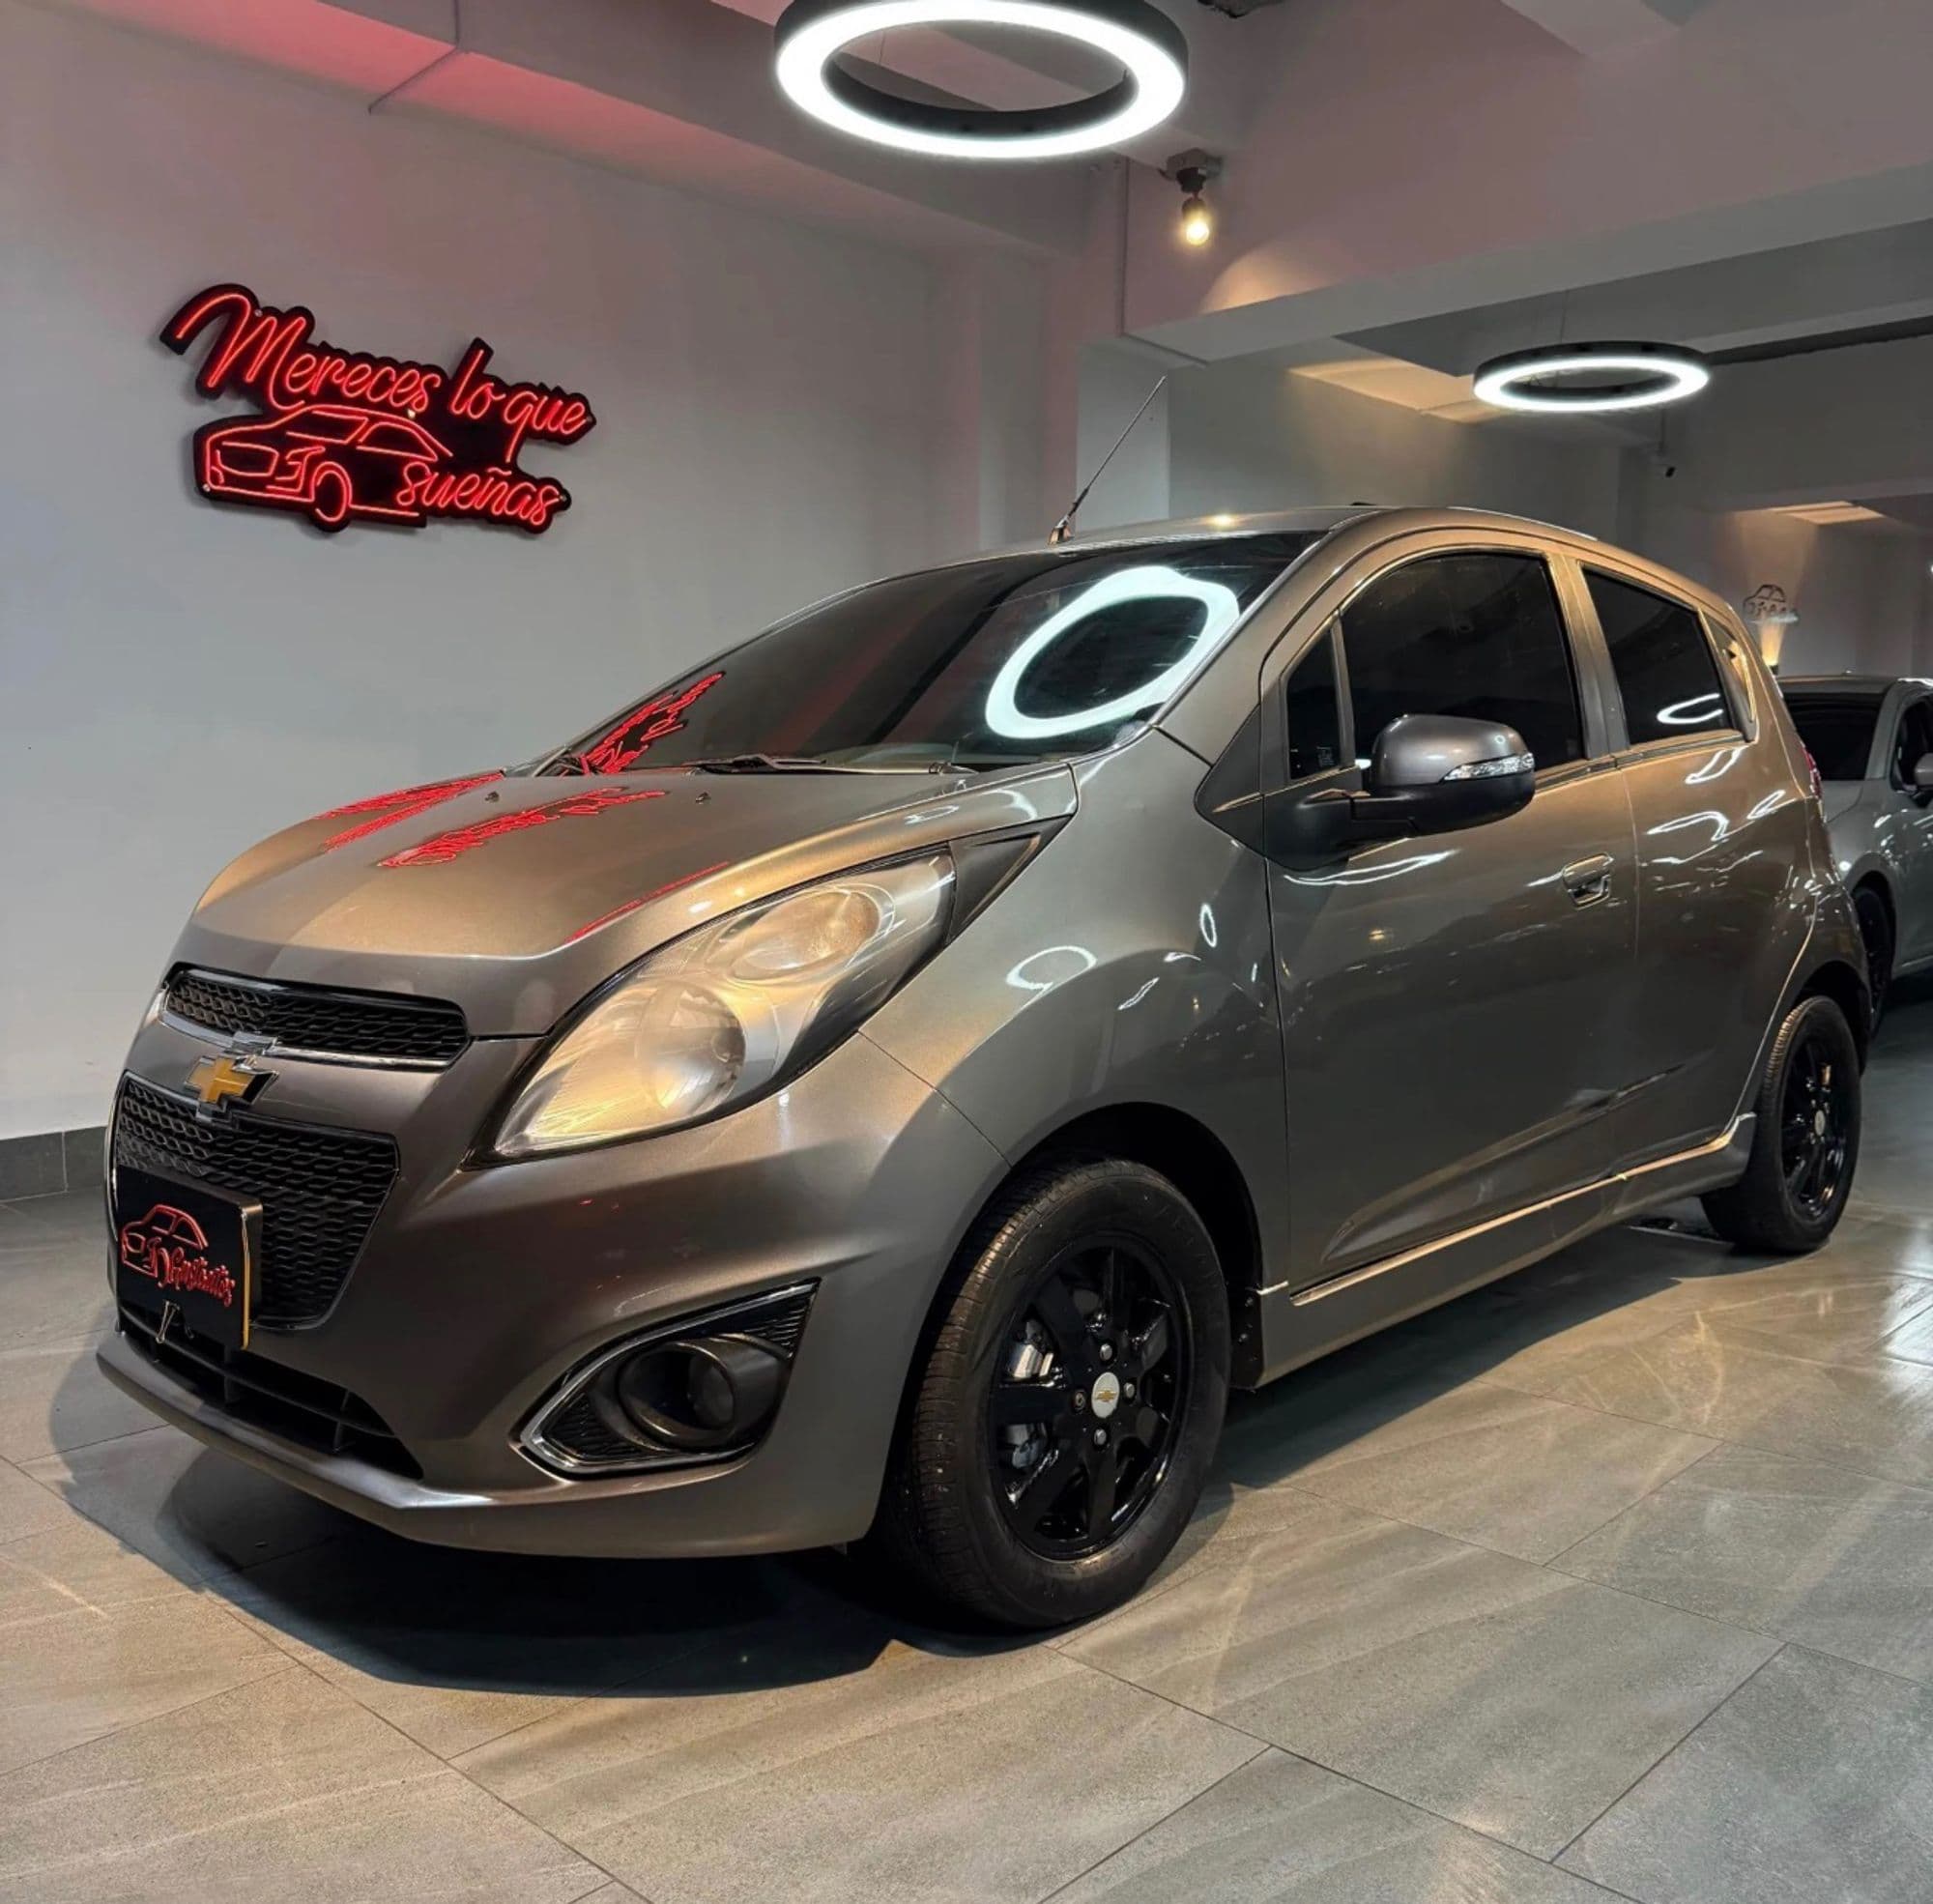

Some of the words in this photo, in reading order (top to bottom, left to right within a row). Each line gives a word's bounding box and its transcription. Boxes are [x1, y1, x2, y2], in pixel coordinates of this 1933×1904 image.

[175, 292, 441, 411] Mereces
[448, 348, 507, 420] lo
[502, 389, 588, 464] que
